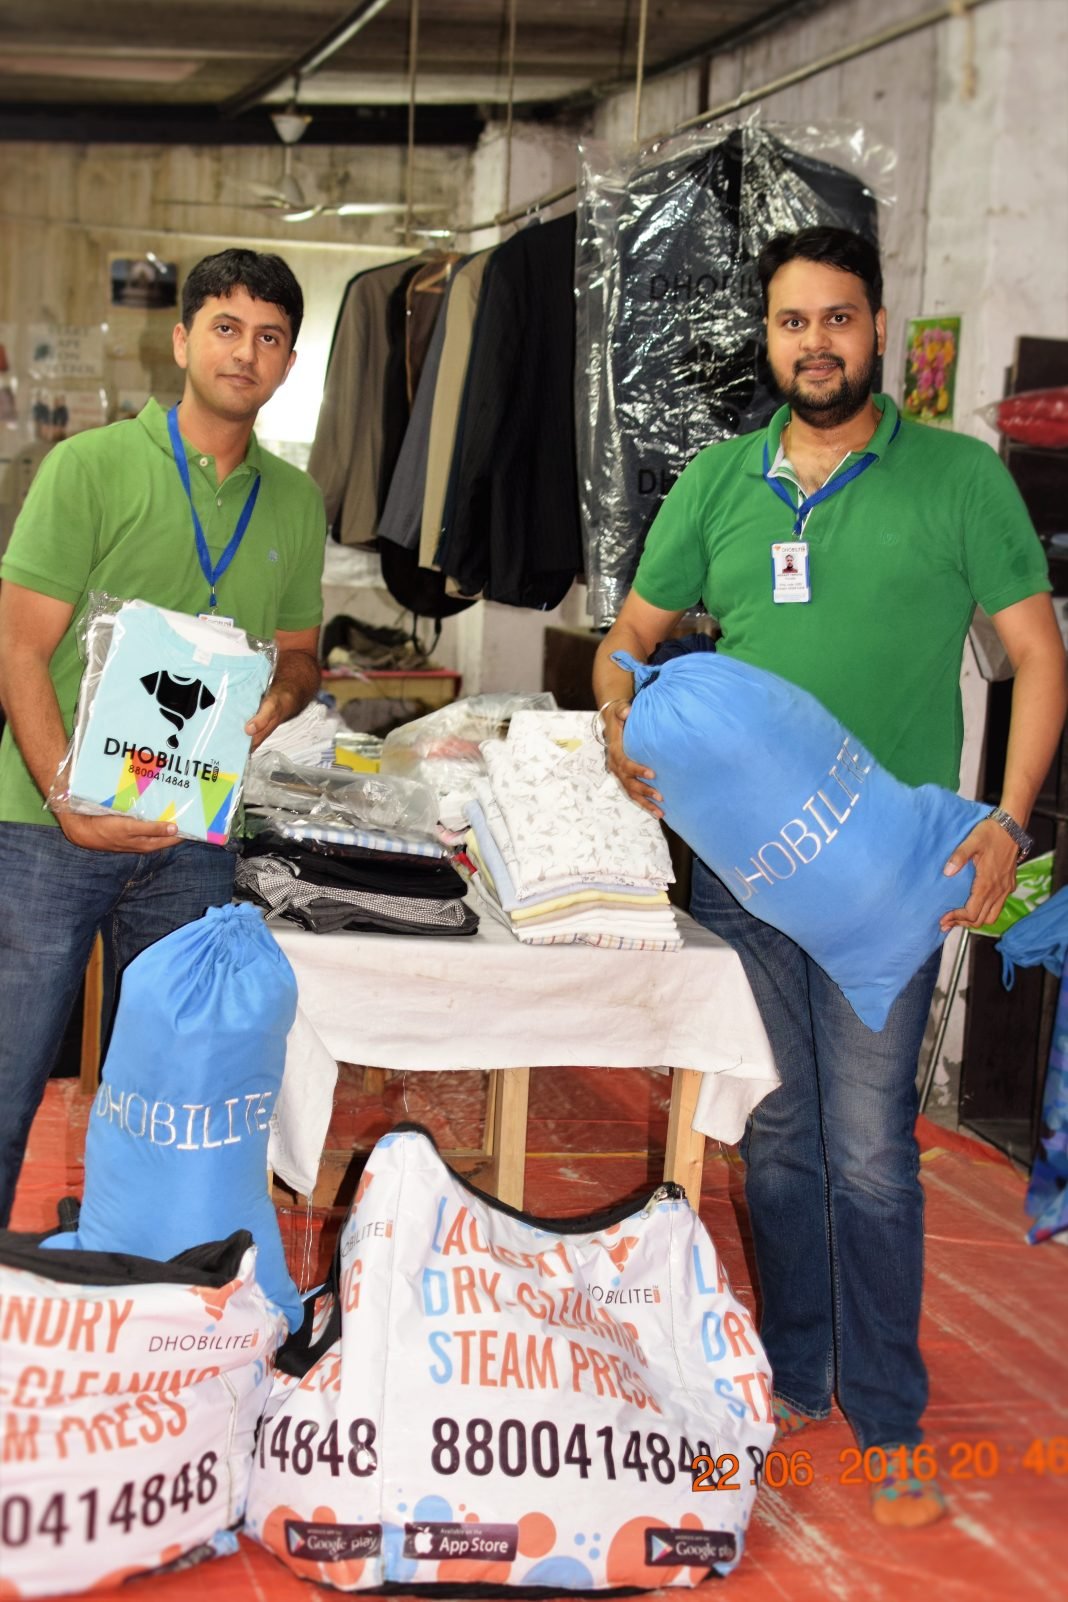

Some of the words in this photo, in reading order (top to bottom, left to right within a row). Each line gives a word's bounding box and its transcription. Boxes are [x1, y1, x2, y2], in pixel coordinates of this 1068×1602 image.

[103, 737, 213, 781] DHOBILITE
[128, 764, 190, 789] 8800414848
[149, 1333, 253, 1352] DHOBILITE
[427, 1330, 560, 1389] STEAM
[1, 1450, 218, 1548] 0414848
[307, 1535, 347, 1562] Google
[439, 1537, 470, 1556] App
[470, 1537, 509, 1553] Store
[676, 1541, 717, 1561] Google
